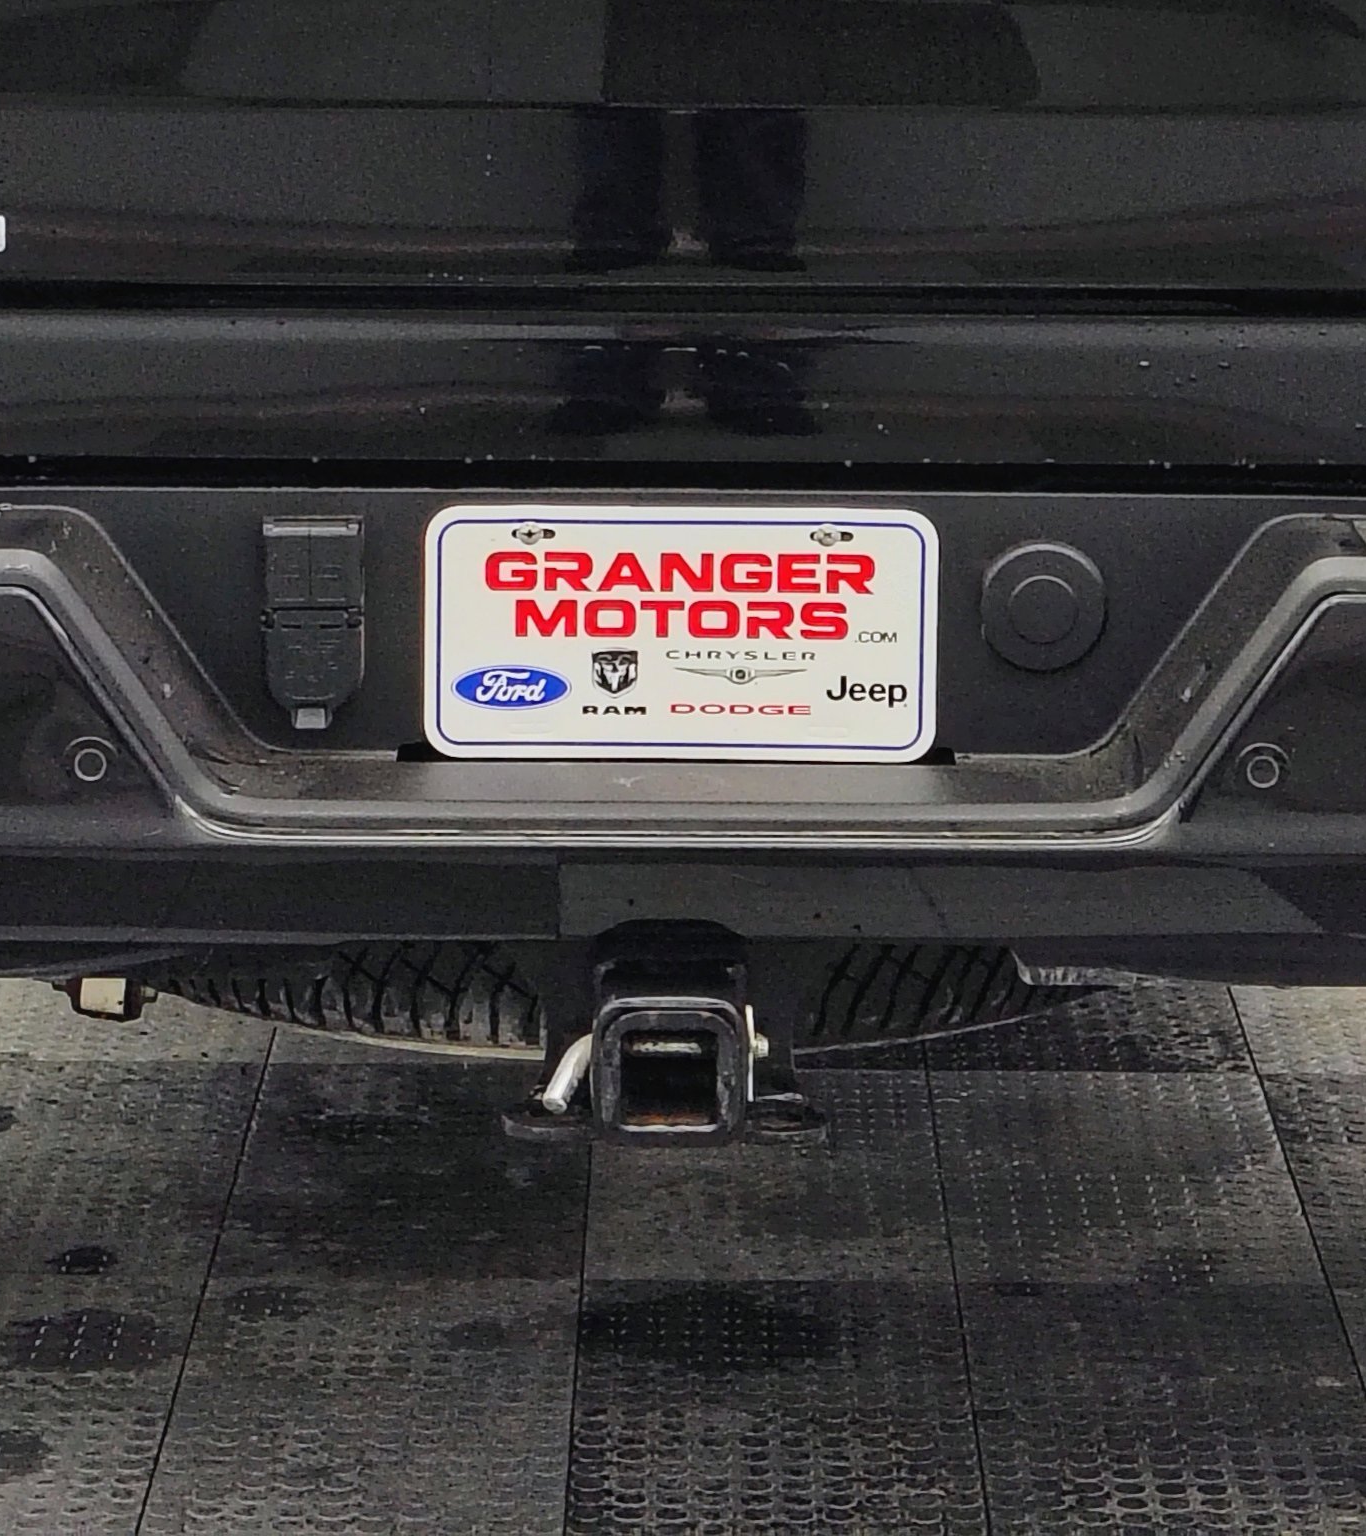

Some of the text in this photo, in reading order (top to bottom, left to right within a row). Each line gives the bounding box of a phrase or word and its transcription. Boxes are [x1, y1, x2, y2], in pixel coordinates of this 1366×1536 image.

[485, 550, 875, 595] GRANGER
[514, 599, 898, 644] MOTORS .COM
[665, 649, 817, 662] CHRYSLER
[475, 669, 548, 703] Ford
[825, 675, 908, 709] Jeep
[581, 704, 648, 716] RAM
[669, 703, 812, 716] DODGE
